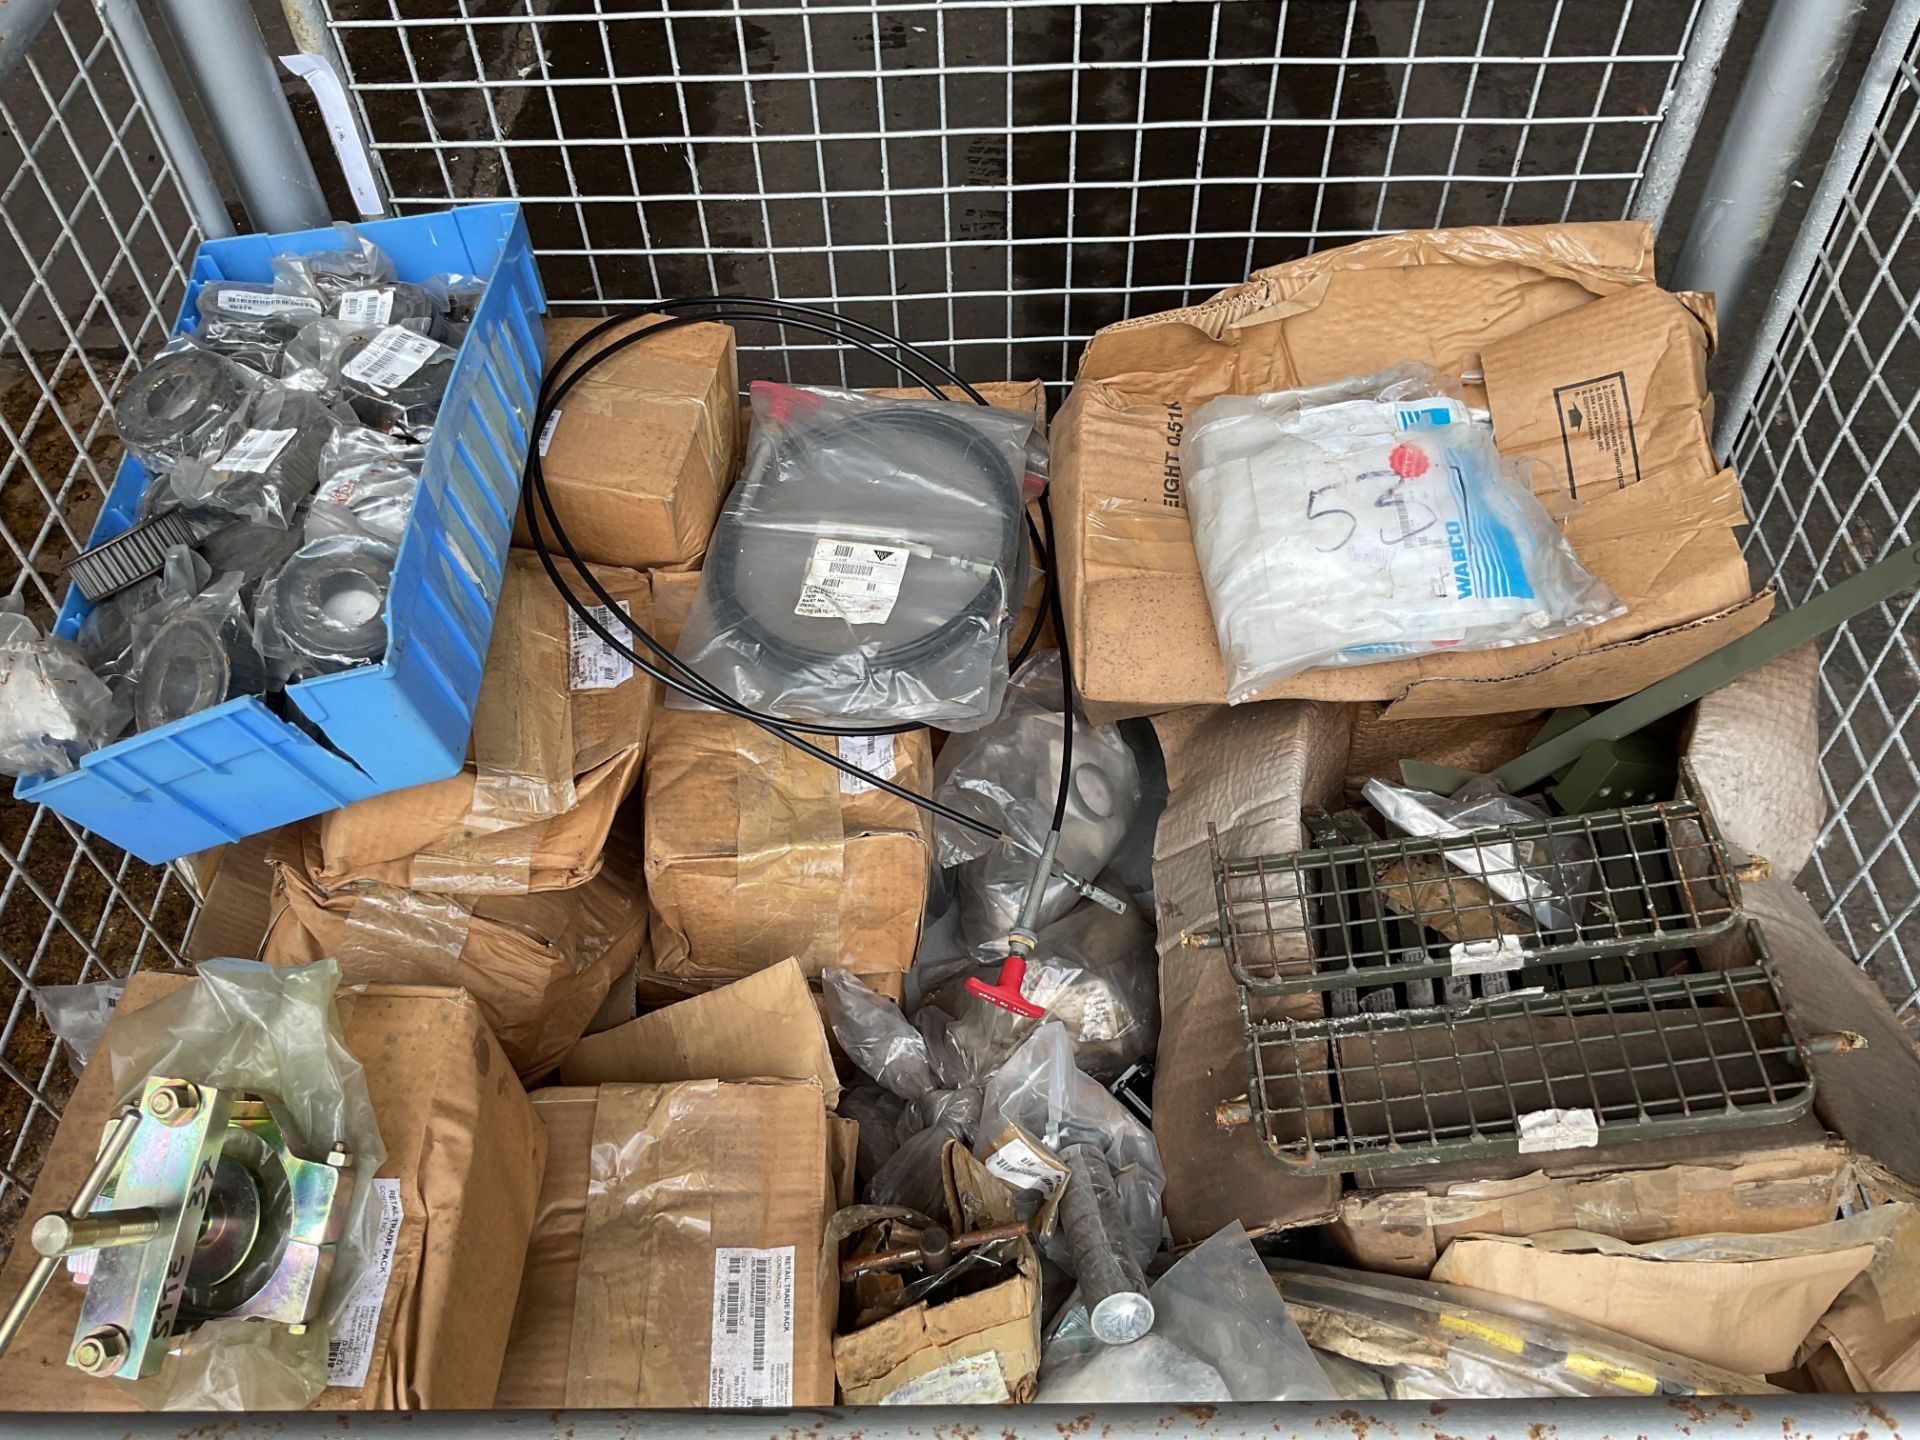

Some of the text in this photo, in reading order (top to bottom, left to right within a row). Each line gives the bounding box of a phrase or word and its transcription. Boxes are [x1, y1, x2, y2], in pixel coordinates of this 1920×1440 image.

[1445, 521, 1472, 600] WABCO
[380, 1189, 399, 1274] RETAIL TRADE PACK
[783, 1311, 791, 1332] PACK
